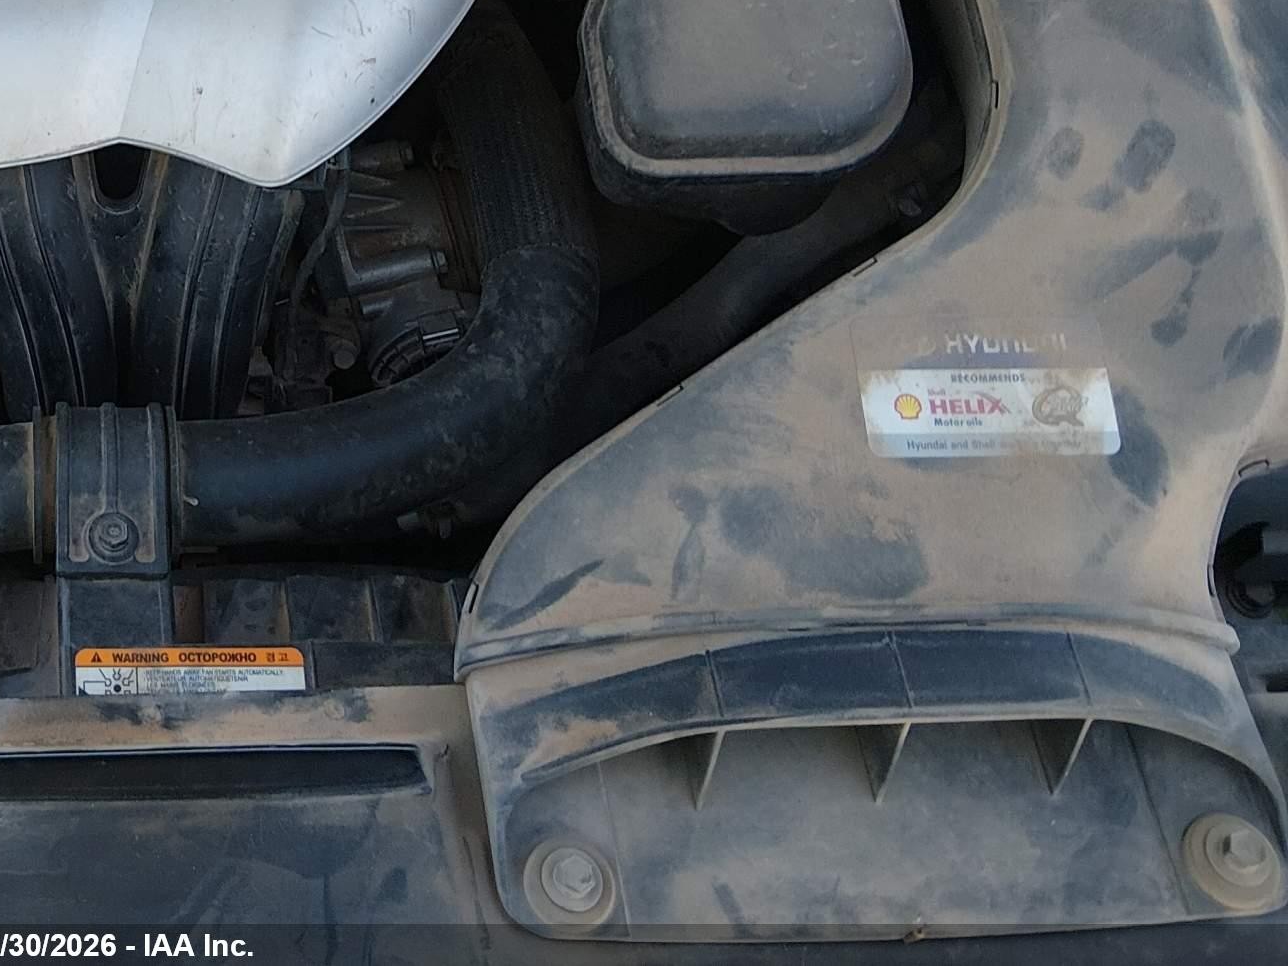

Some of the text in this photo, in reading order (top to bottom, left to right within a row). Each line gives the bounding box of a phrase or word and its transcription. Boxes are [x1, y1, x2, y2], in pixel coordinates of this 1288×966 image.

[928, 398, 1004, 416] HELIX
[934, 418, 963, 427] Motor
[906, 439, 948, 451] Hyundai
[951, 439, 969, 449] and
[113, 652, 169, 663] WARNING
[179, 651, 257, 663] ОСТОРОЖНО
